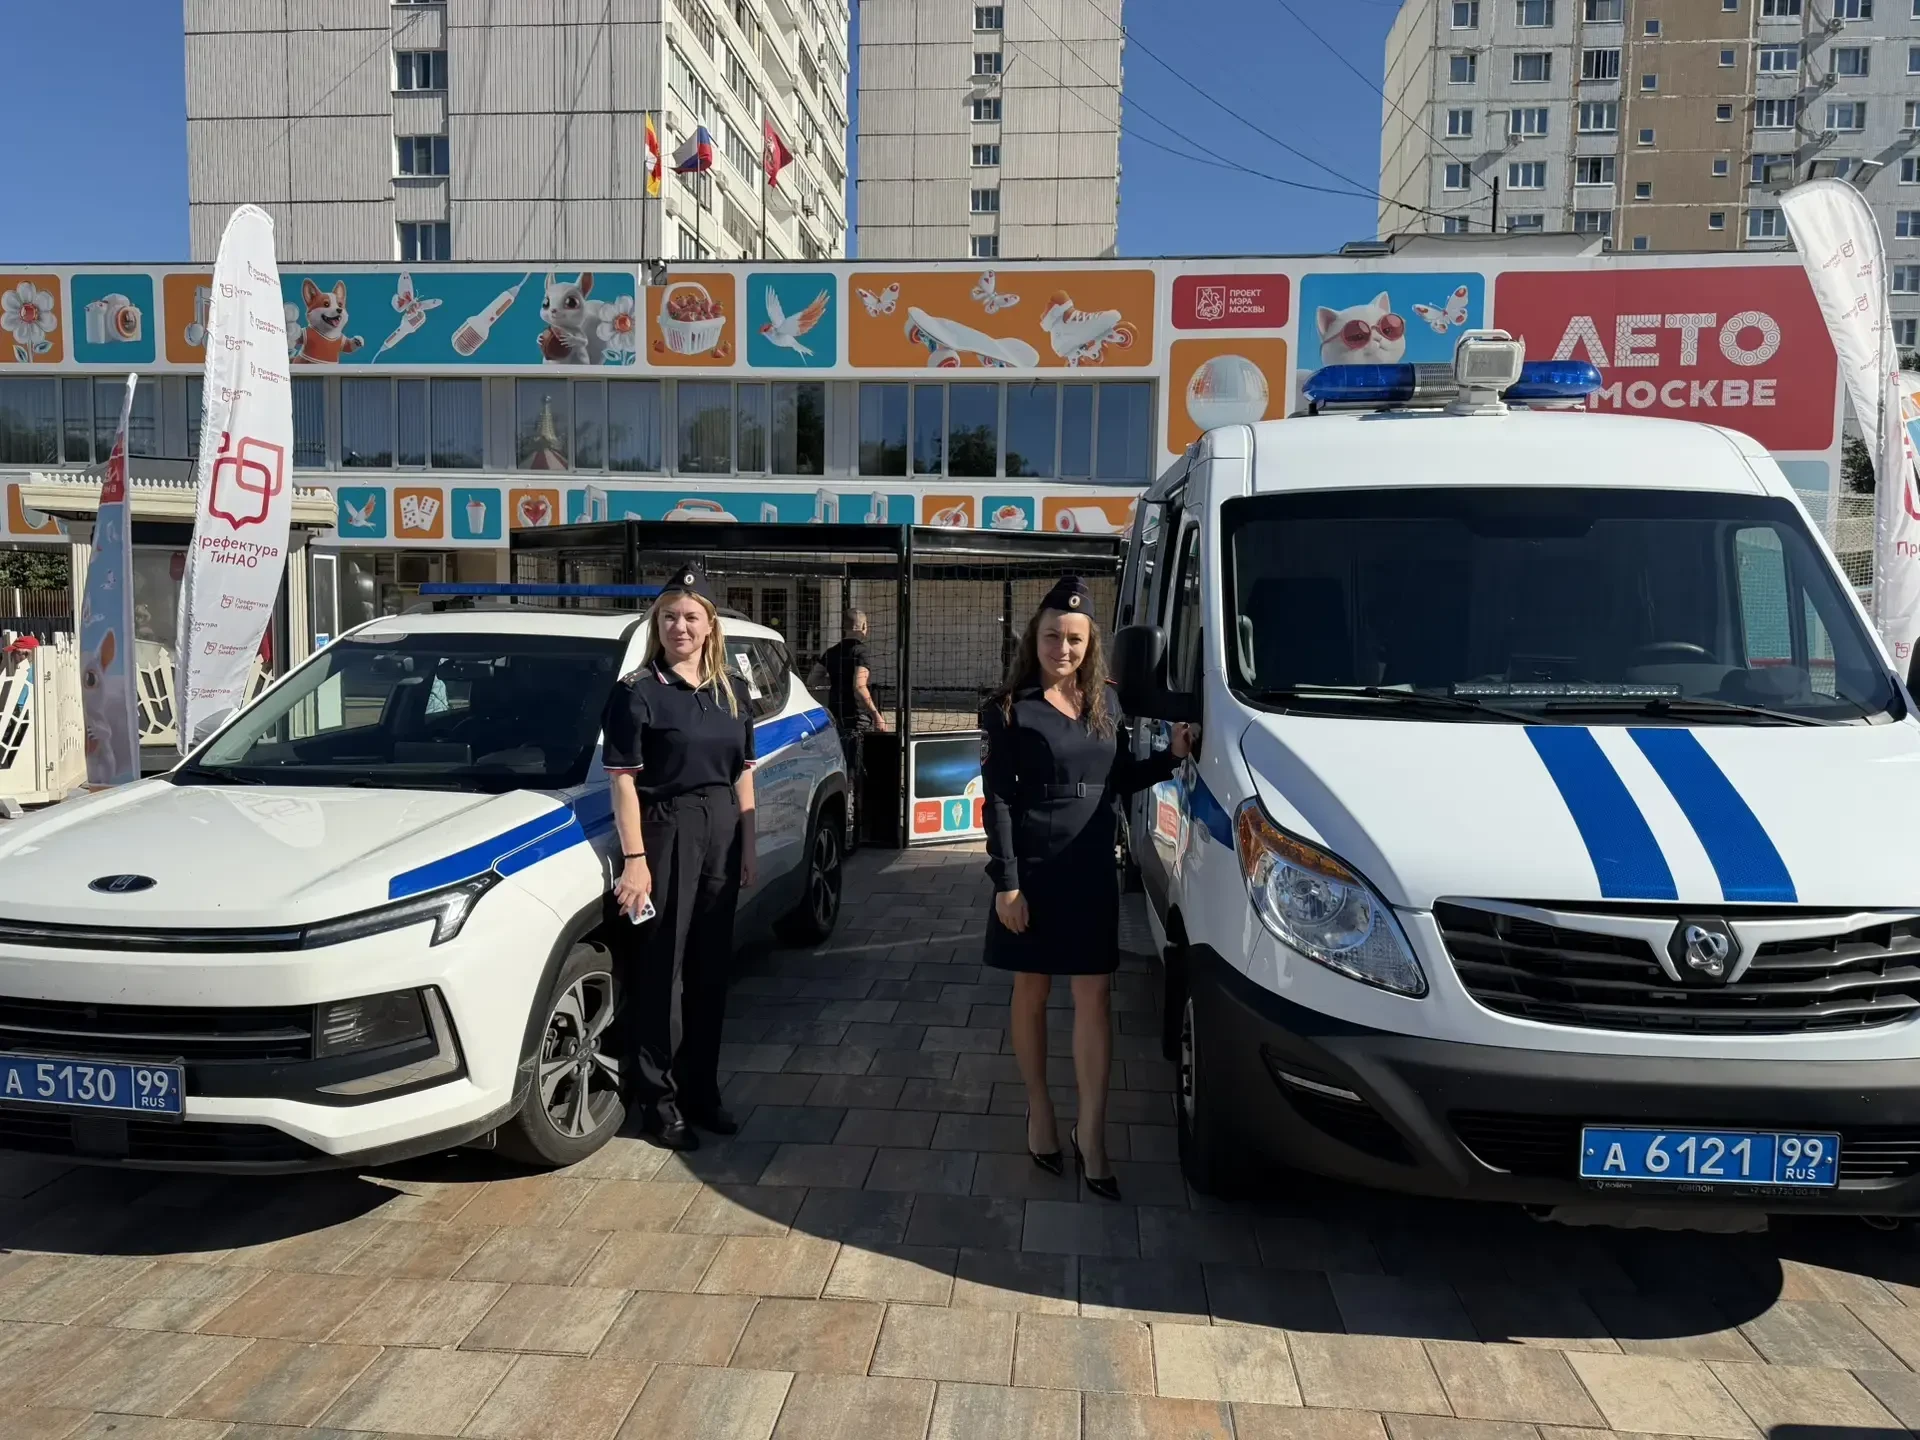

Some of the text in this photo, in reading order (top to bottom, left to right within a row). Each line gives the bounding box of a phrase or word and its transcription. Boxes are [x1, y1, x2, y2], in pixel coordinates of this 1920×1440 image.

[1229, 289, 1262, 297] ПРОЕКТ
[1229, 297, 1253, 305] МЭРА
[1229, 305, 1265, 313] МОСКВЫ
[1552, 310, 1781, 368] ЛЕТО
[1589, 379, 1777, 409] МОСКВЕ
[211, 551, 258, 568] ТиНАО
[5, 1063, 169, 1102] А 5130 99
[141, 1096, 166, 1108] RUS
[1603, 1135, 1824, 1176] А 6121 99
[1785, 1167, 1816, 1181] RUS
